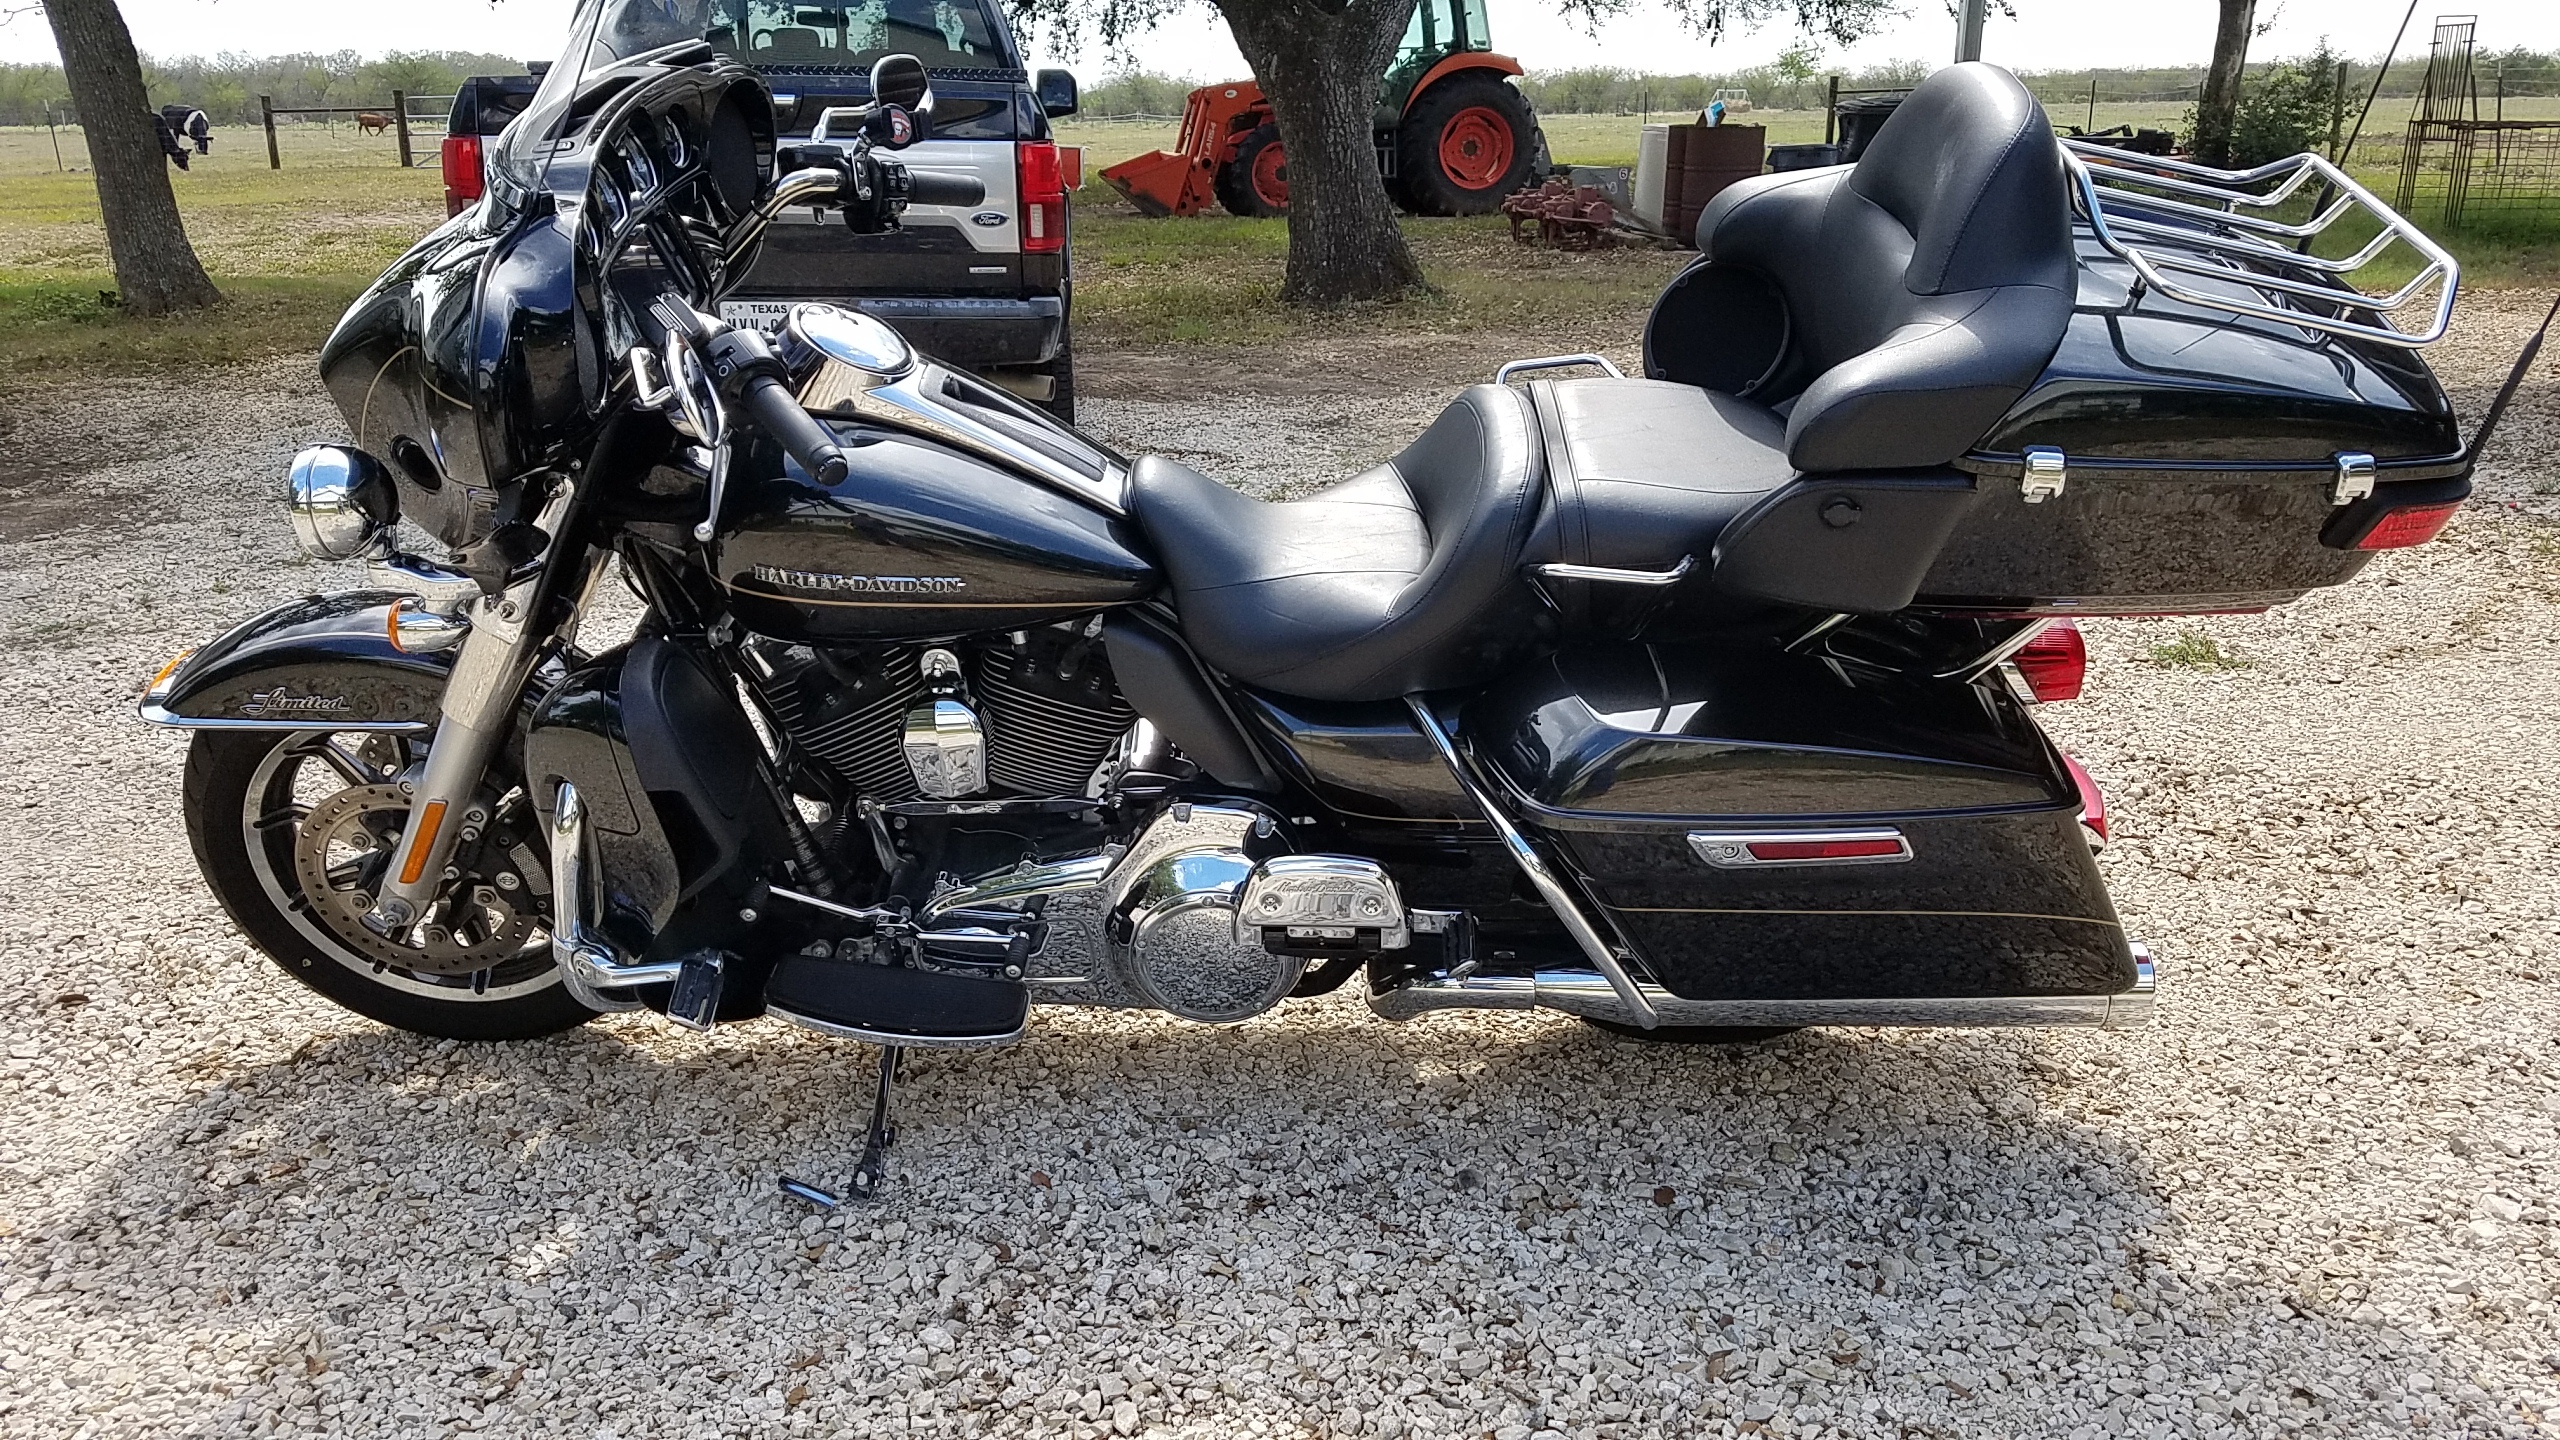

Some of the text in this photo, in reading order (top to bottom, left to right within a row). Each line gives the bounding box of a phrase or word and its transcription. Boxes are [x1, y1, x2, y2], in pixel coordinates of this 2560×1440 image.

[979, 214, 1001, 225] Ford
[750, 304, 788, 314] TEXAS
[240, 686, 352, 716] Limited
